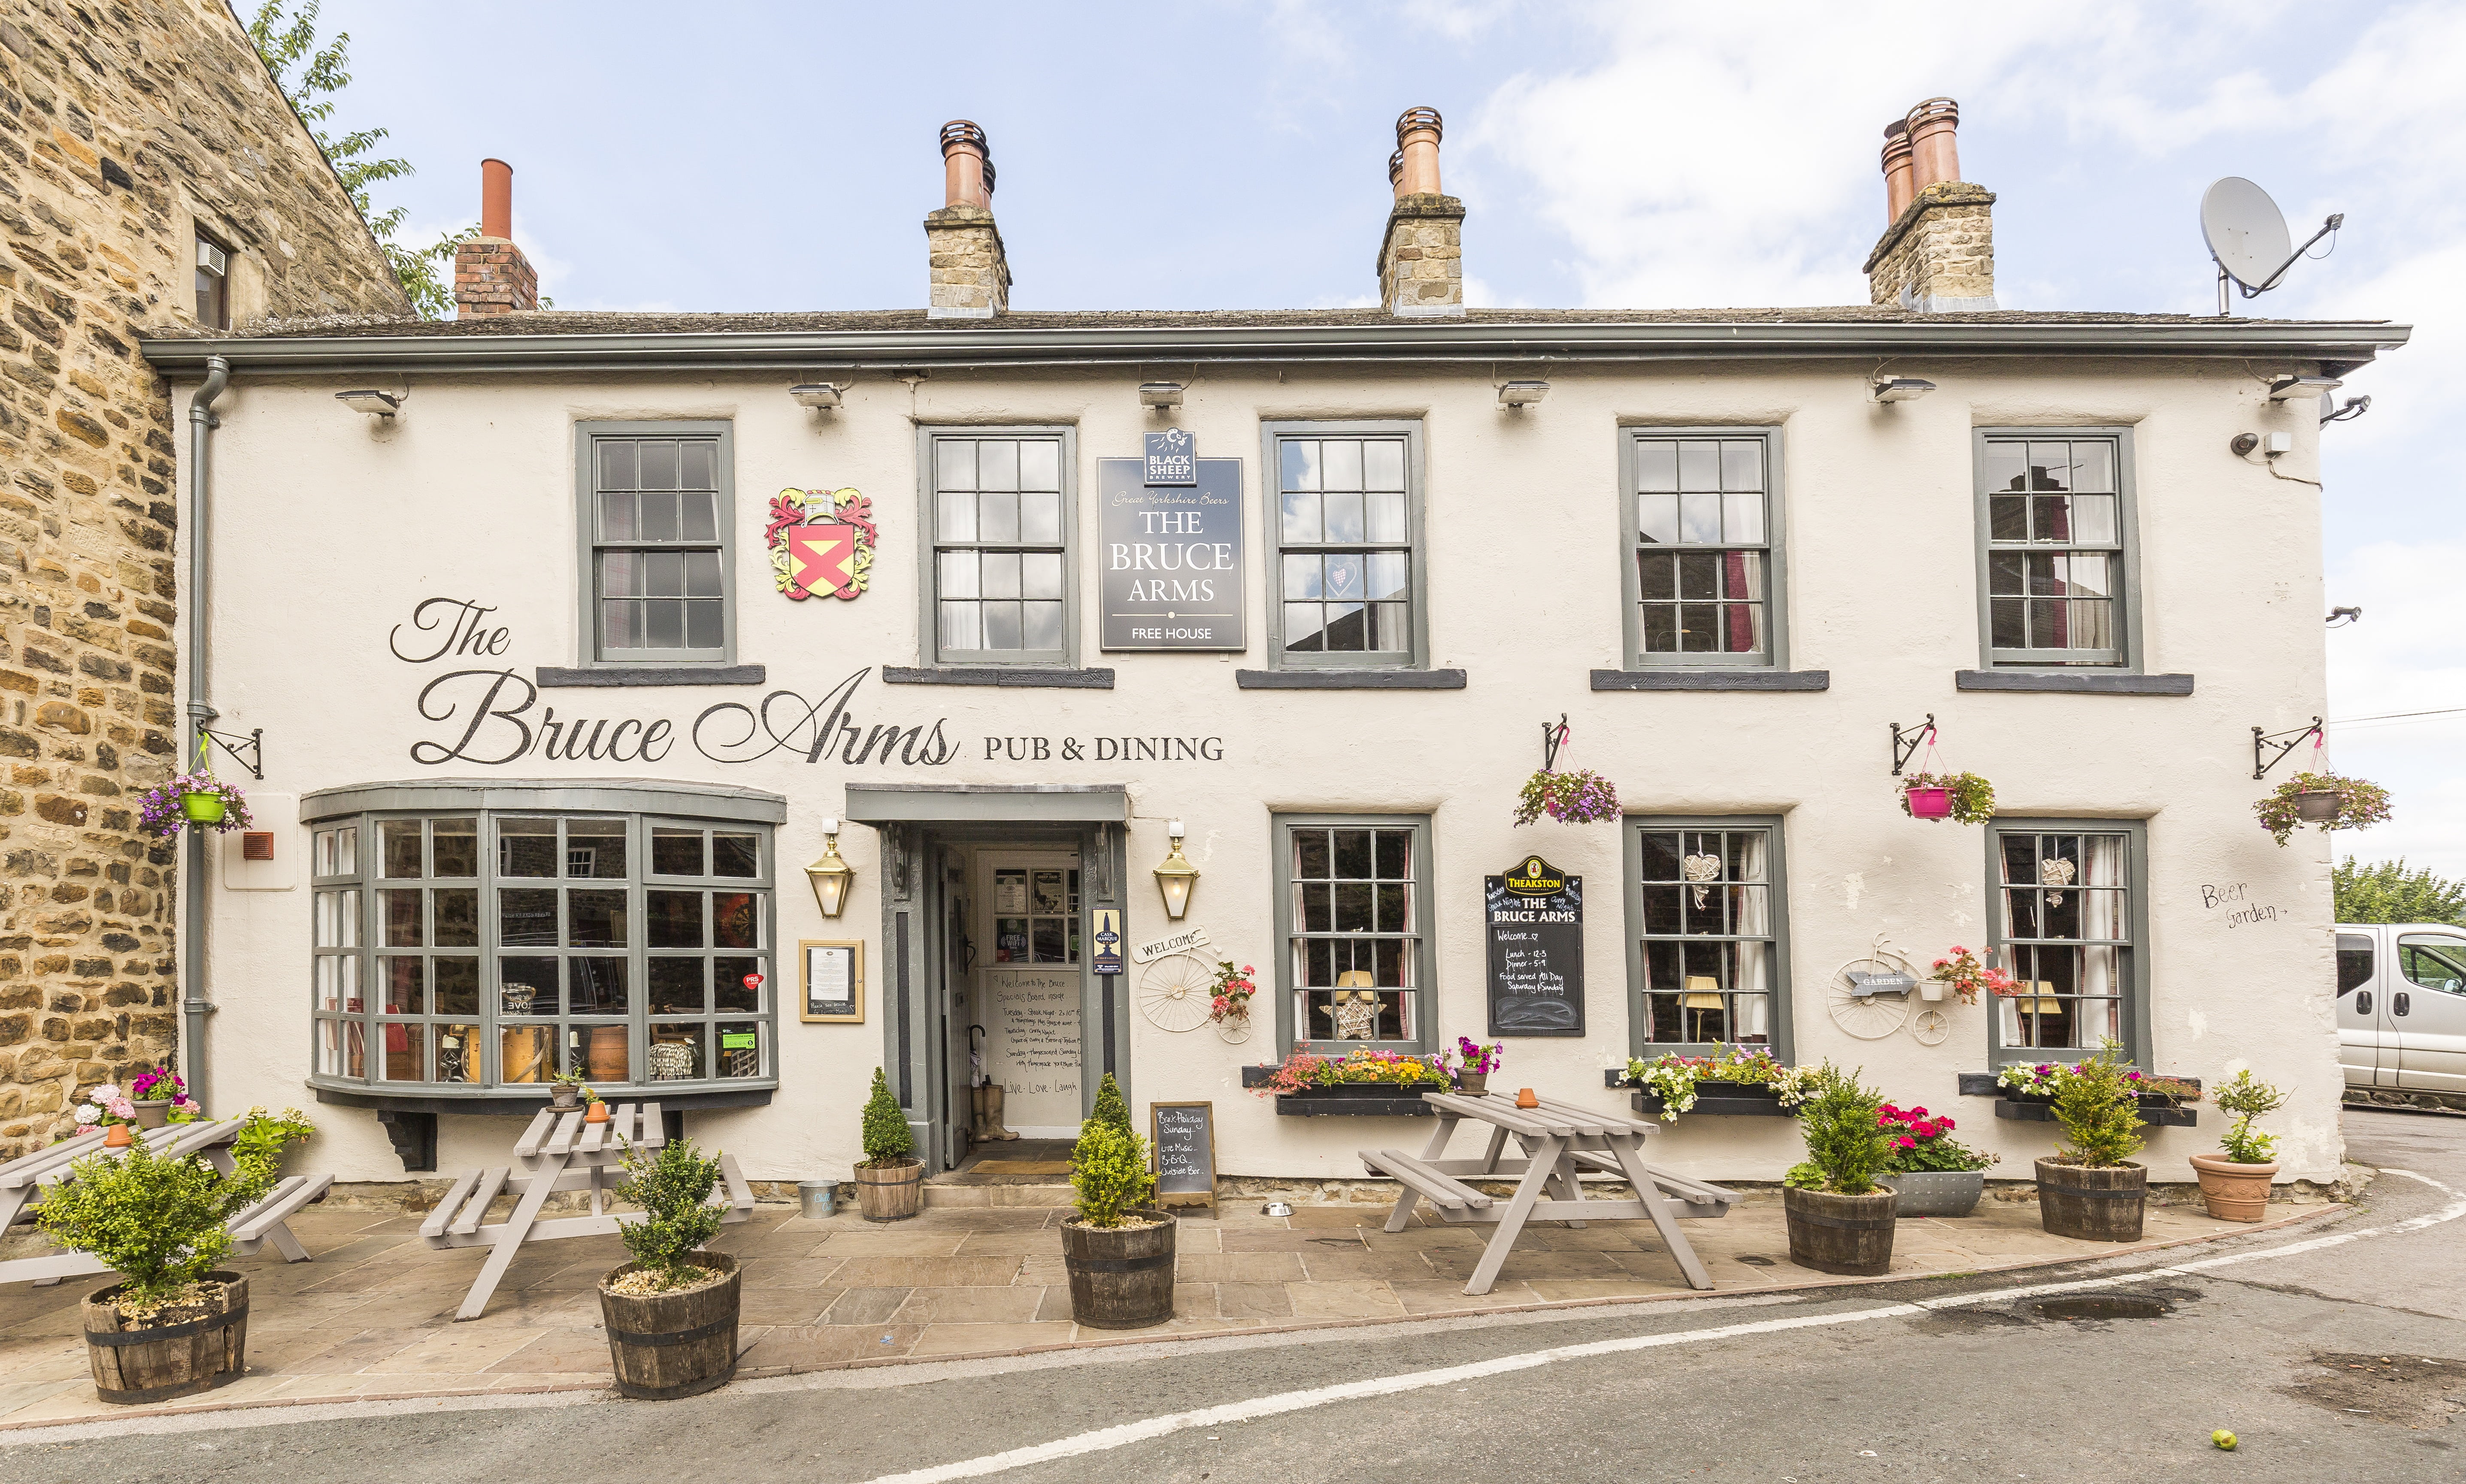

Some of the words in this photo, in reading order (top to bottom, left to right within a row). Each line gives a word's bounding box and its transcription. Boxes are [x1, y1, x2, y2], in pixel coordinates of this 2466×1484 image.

[1149, 455, 1190, 465] BLACK
[1150, 465, 1191, 475] SHEEP
[1112, 491, 1145, 506] Great
[1147, 490, 1197, 505] Yorkshire
[1199, 492, 1230, 505] Beers
[1139, 511, 1204, 534] THE
[1109, 543, 1234, 570] BRUCE
[1127, 579, 1214, 601] ARMS
[390, 597, 511, 663] The
[1132, 628, 1162, 639] FREE
[1165, 628, 1212, 639] HOUSE
[410, 668, 675, 765] Bruce
[692, 667, 960, 766] Arms
[984, 737, 1051, 761] PUB
[1061, 736, 1085, 761] &
[1094, 736, 1224, 761] DINING
[1508, 878, 1560, 888] THEAKSTON
[1487, 886, 1505, 901] Tuesday
[1566, 884, 1581, 905] Thursday
[2202, 883, 2247, 909] Beer
[1503, 897, 1521, 908] Night
[1522, 898, 1547, 909] THE
[1551, 896, 1566, 904] Curry
[1494, 911, 1535, 922] BRUCE
[1539, 911, 1575, 922] ARMS
[2226, 903, 2278, 928] Garden
[1506, 948, 1525, 958] Lunch
[1506, 958, 1527, 971] Dinner
[1002, 976, 1030, 988] Welcome
[1030, 978, 1036, 986] to
[1036, 979, 1045, 990] The
[1500, 972, 1515, 980] Food
[1539, 972, 1548, 980] All
[1549, 972, 1563, 986] Day
[1863, 978, 1903, 986] GARDEN
[1507, 981, 1536, 994] Saturday
[1541, 981, 1563, 995] Sunday
[997, 991, 1025, 1006] Specials
[1027, 992, 1045, 1002] Board
[1003, 1008, 1023, 1018] Tuesday
[1004, 1026, 1026, 1037] Thursday
[1042, 1029, 1056, 1037] Night
[1006, 1048, 1026, 1058] Sunday
[1059, 1048, 1077, 1058] Sunday
[1004, 1078, 1023, 1095] Live
[1029, 1082, 1048, 1094] Love
[1055, 1079, 1077, 1096] Laugh
[1161, 1143, 1173, 1152] Live
[1160, 1167, 1186, 1176] Outside
[814, 1193, 830, 1203] Chill
[822, 1202, 832, 1212] Out
